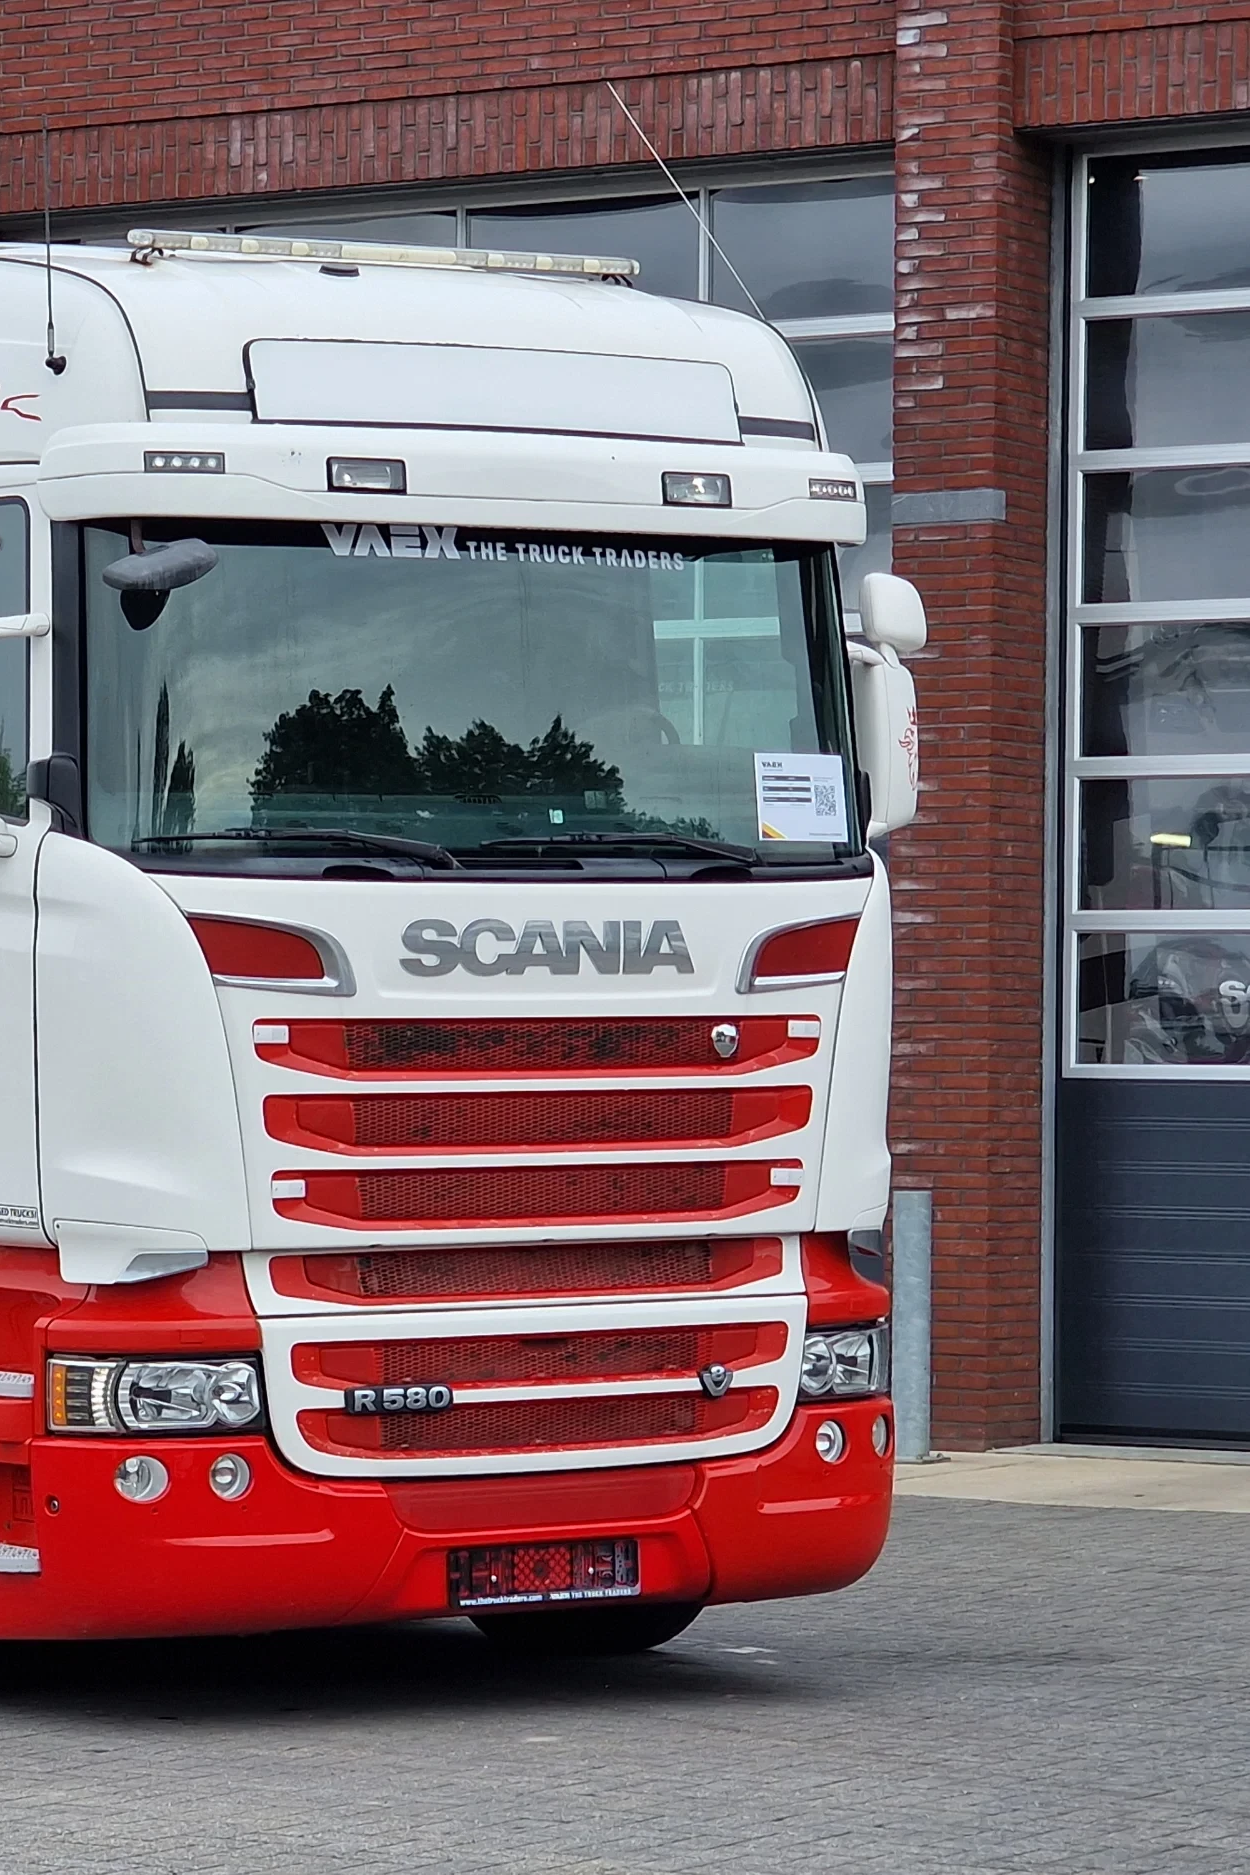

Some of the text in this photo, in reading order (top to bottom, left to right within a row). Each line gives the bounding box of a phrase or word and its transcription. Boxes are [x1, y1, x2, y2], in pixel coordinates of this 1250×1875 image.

[320, 524, 685, 570] VAEX THE TRUCK TRADERS
[399, 918, 695, 977] SCANIA
[1219, 981, 1250, 1005] S
[354, 1386, 450, 1411] R 580
